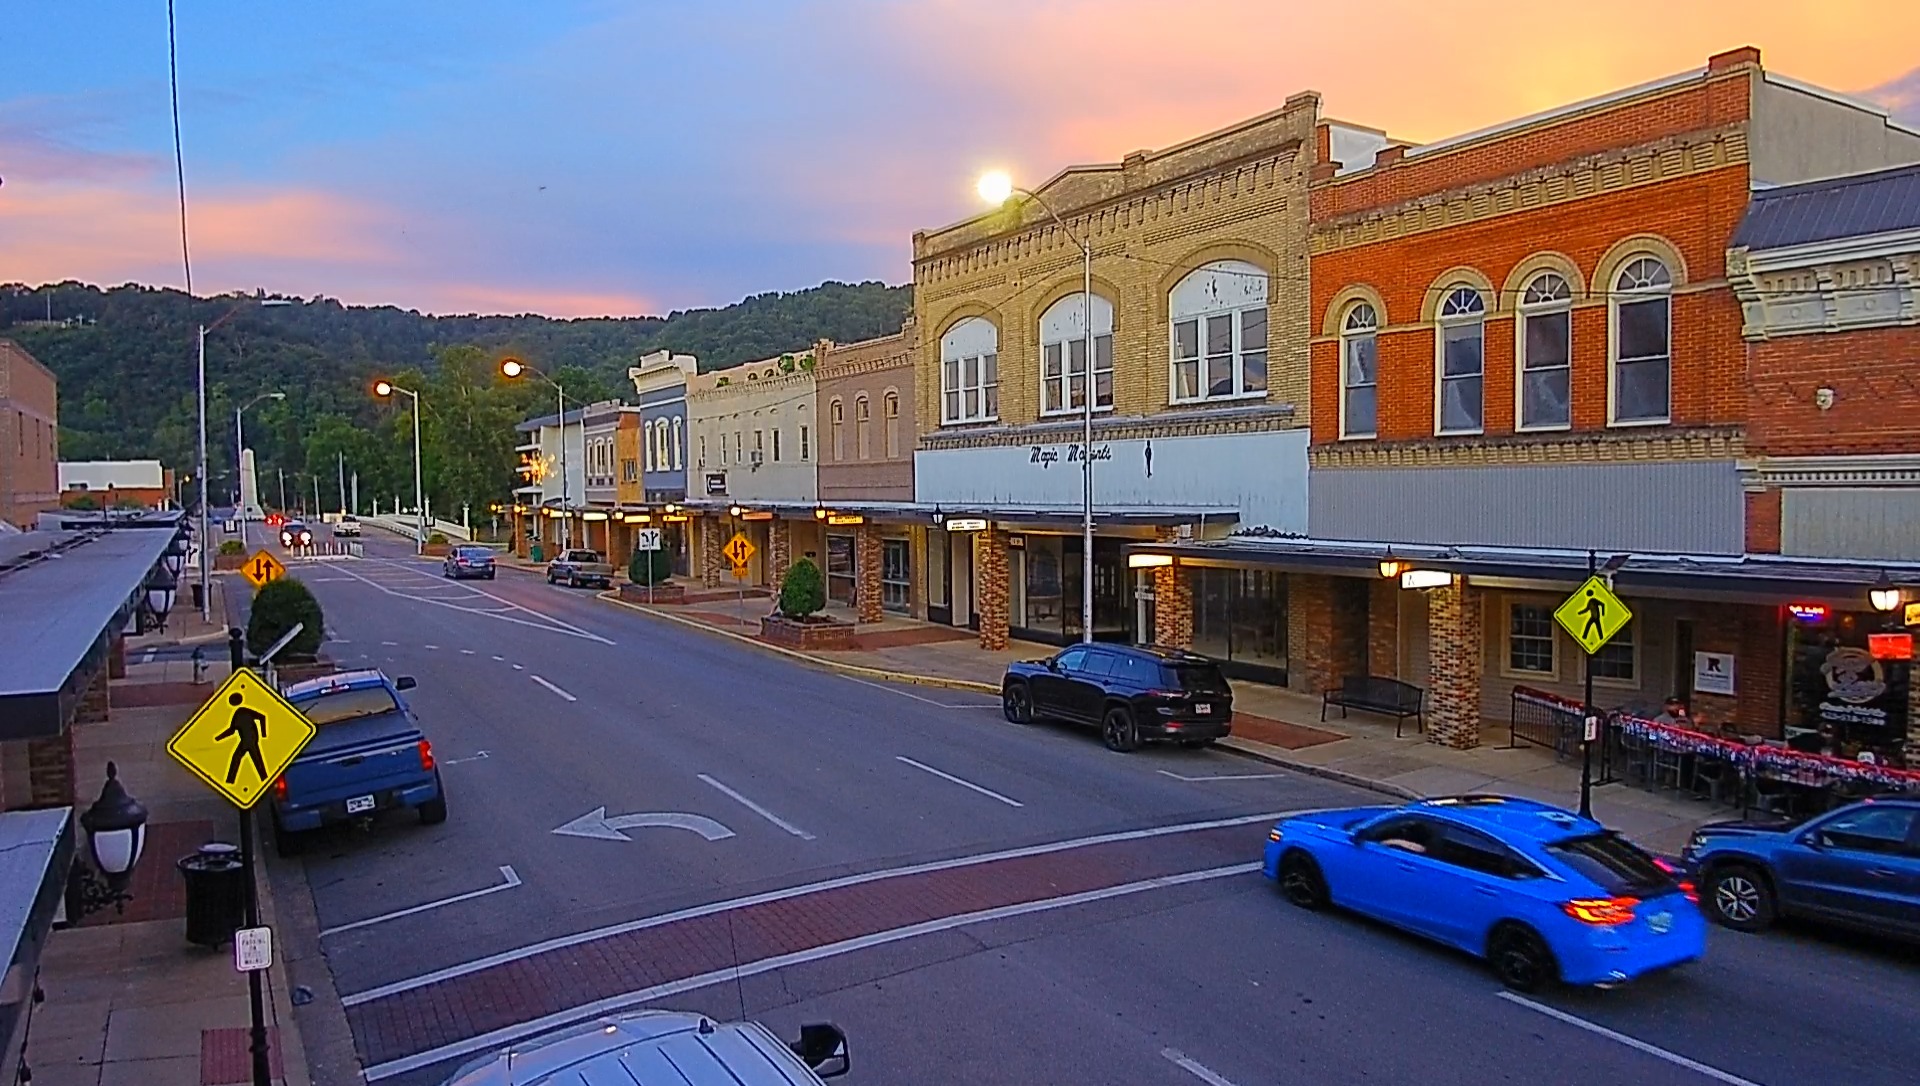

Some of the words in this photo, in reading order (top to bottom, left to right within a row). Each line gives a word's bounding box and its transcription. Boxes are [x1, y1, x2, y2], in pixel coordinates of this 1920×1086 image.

[1030, 446, 1059, 469] Magic
[1067, 444, 1112, 462] Moents
[1708, 657, 1722, 673] R
